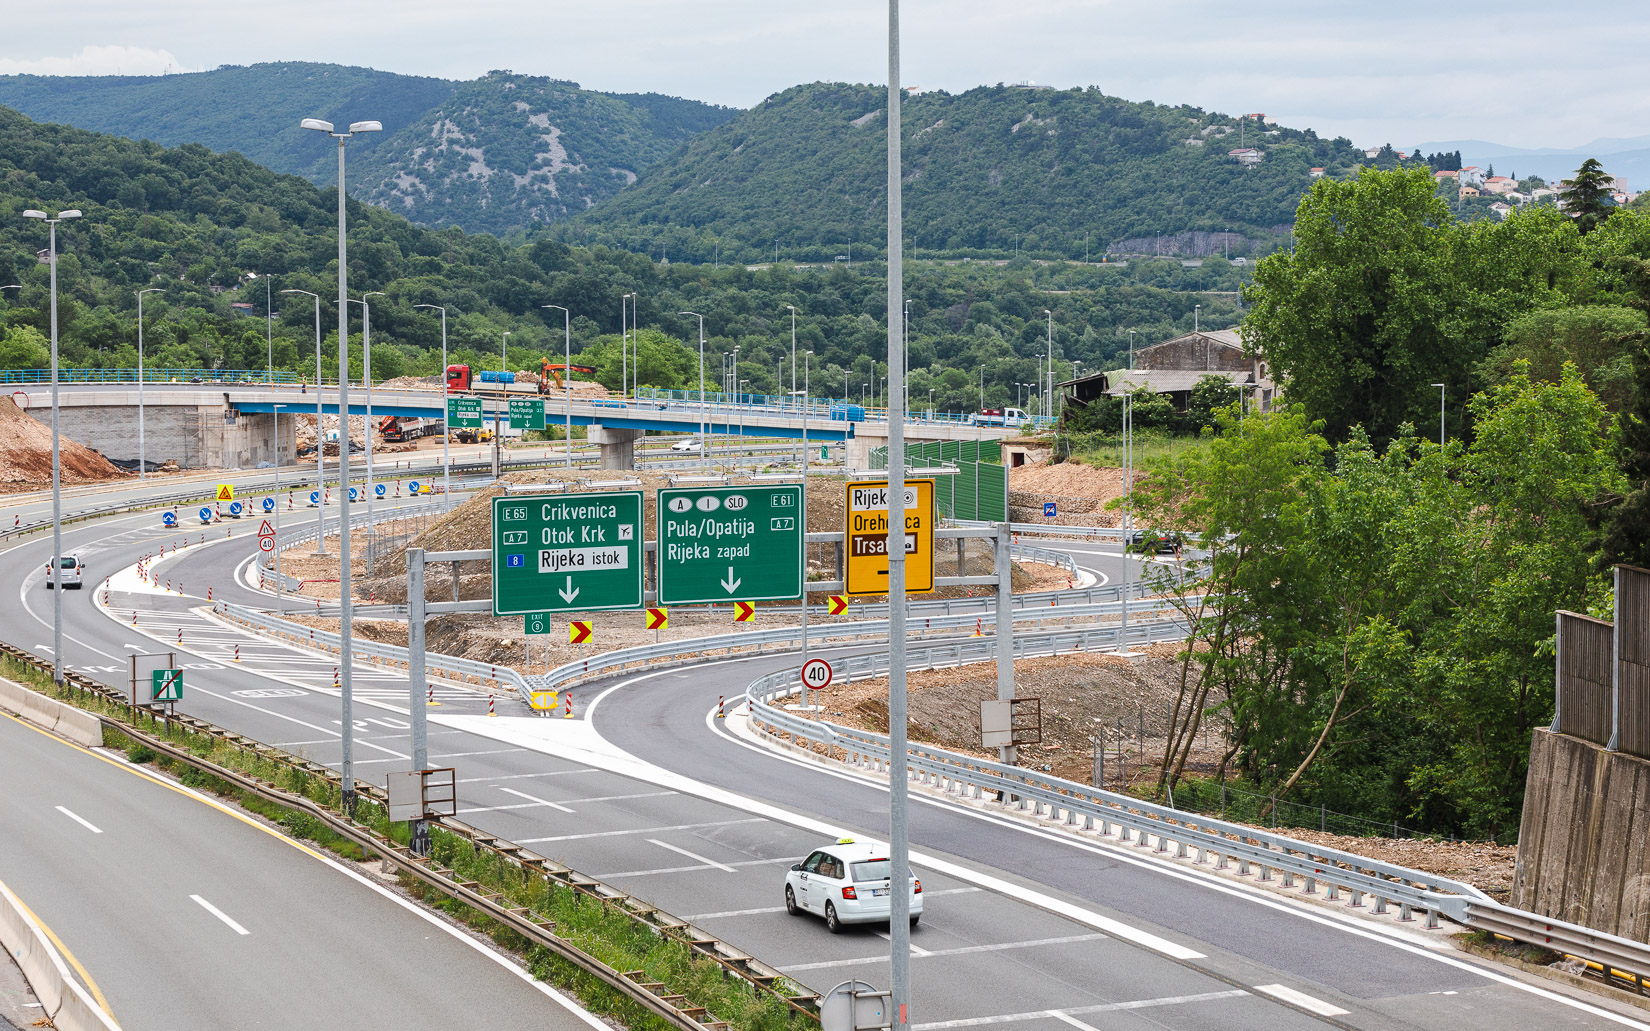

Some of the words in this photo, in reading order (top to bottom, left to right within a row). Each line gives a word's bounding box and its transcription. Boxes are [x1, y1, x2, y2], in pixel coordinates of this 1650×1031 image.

[677, 500, 684, 510] A
[707, 498, 710, 509] I
[728, 498, 744, 508] SLO
[773, 496, 778, 505] E
[781, 496, 791, 505] 61
[854, 488, 888, 509] Rijek
[505, 510, 510, 519] E
[513, 509, 525, 519] 65
[542, 502, 616, 521] Crikvenica
[667, 518, 755, 540] Pula/Opatija
[776, 520, 781, 529] A
[784, 520, 789, 528] 7
[854, 514, 920, 532] Orehca
[509, 534, 514, 542] A
[517, 533, 522, 542] 7
[542, 526, 575, 544] Otok
[581, 525, 605, 542] Krk
[512, 556, 519, 565] 8
[542, 550, 584, 571] Rijeka
[592, 551, 620, 565] istok
[668, 542, 710, 564] Rijeka
[717, 543, 750, 560] zapad
[809, 666, 825, 681] 40
